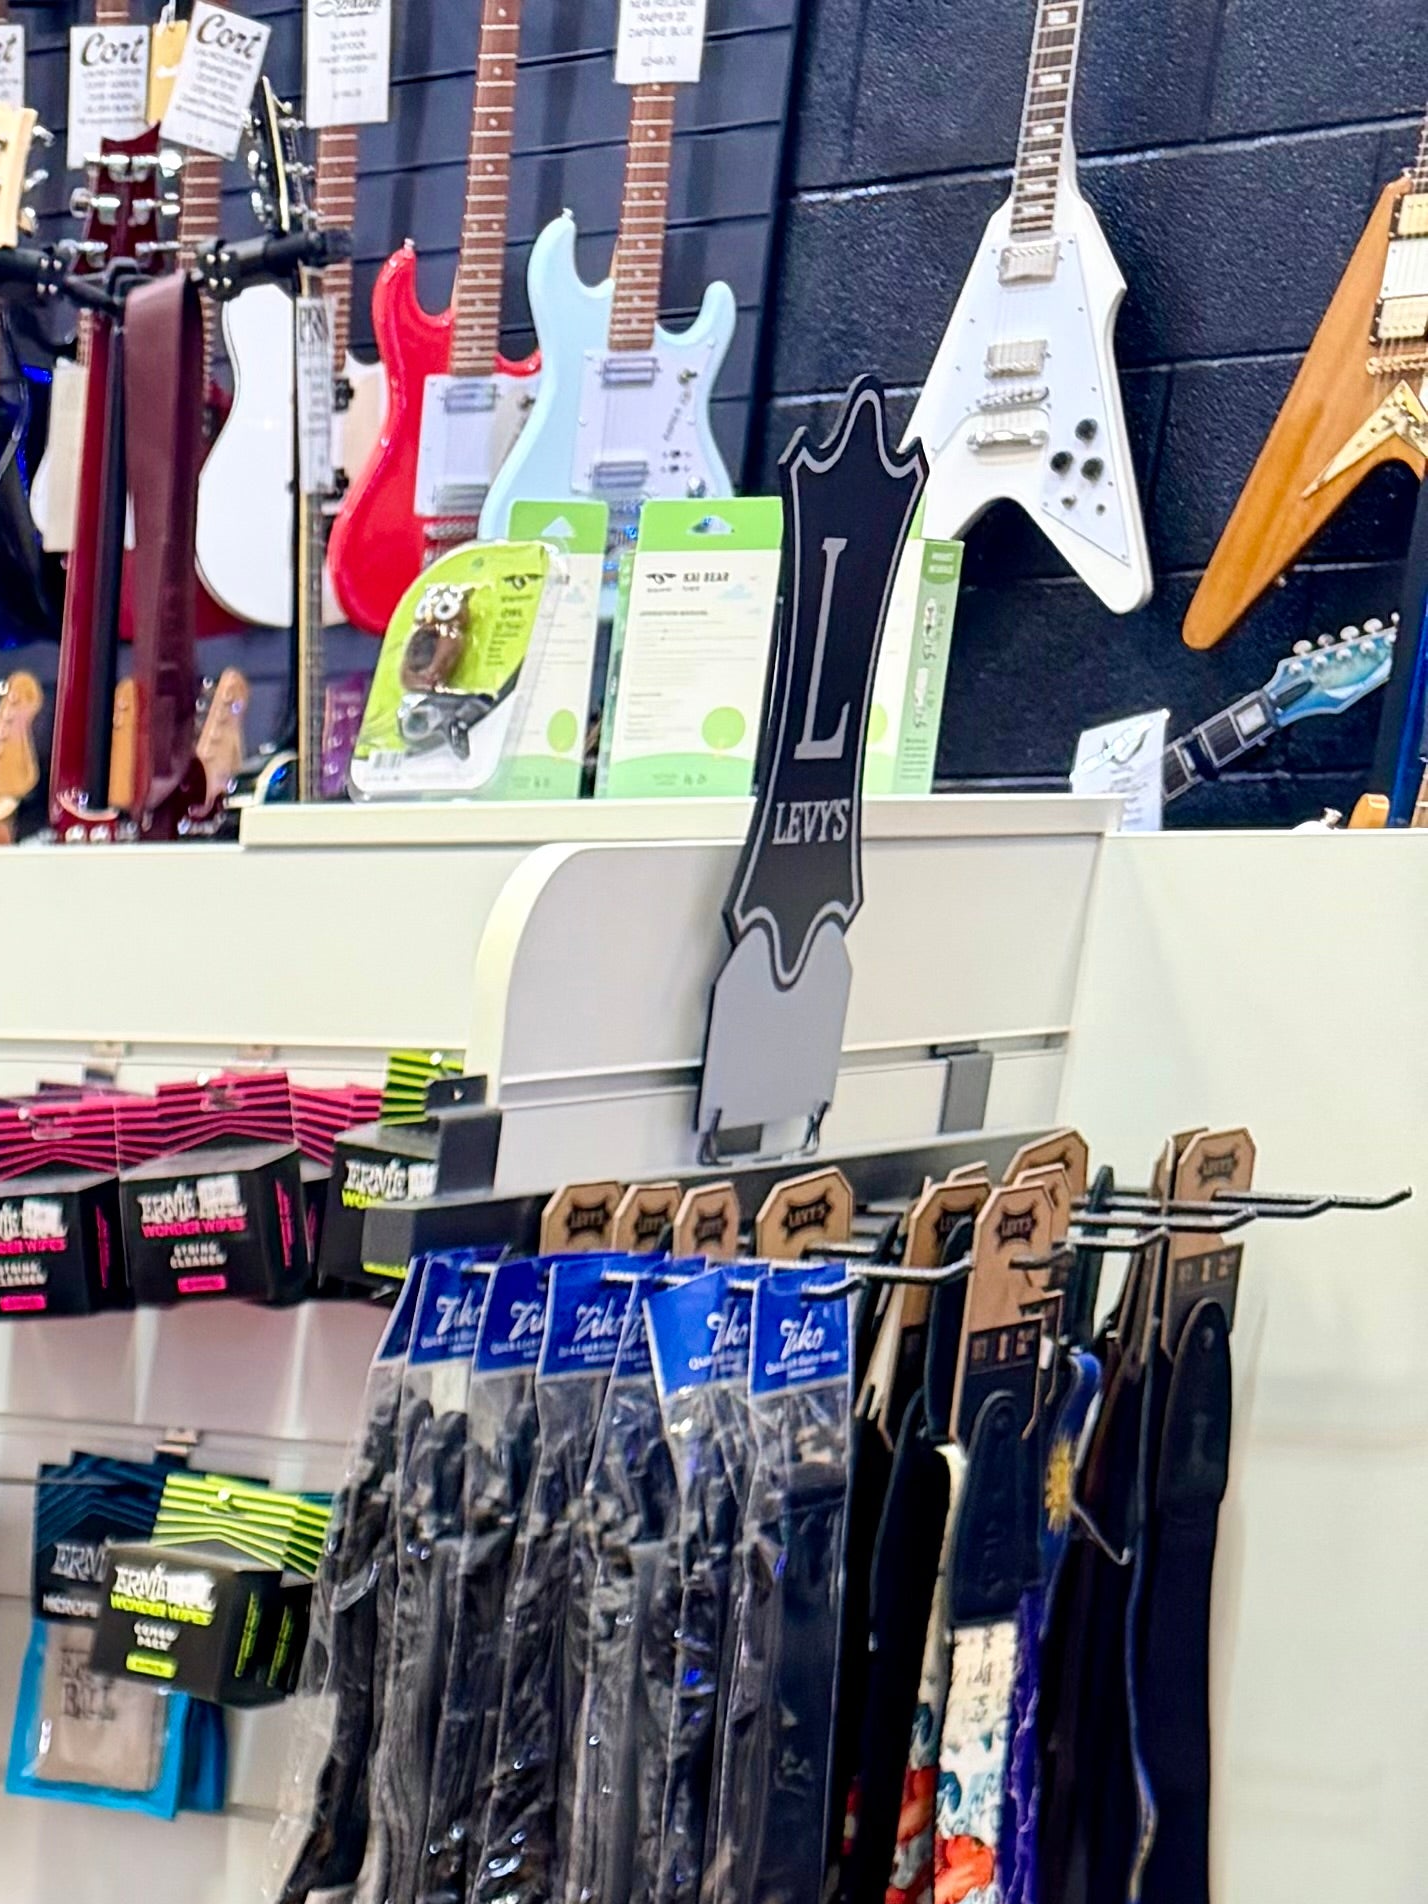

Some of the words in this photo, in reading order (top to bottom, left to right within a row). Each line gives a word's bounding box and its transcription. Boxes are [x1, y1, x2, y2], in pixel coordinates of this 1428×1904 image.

[80, 32, 144, 66] Cort
[196, 14, 262, 59] Cort
[793, 537, 851, 760] L
[780, 1309, 826, 1361] Tiko
